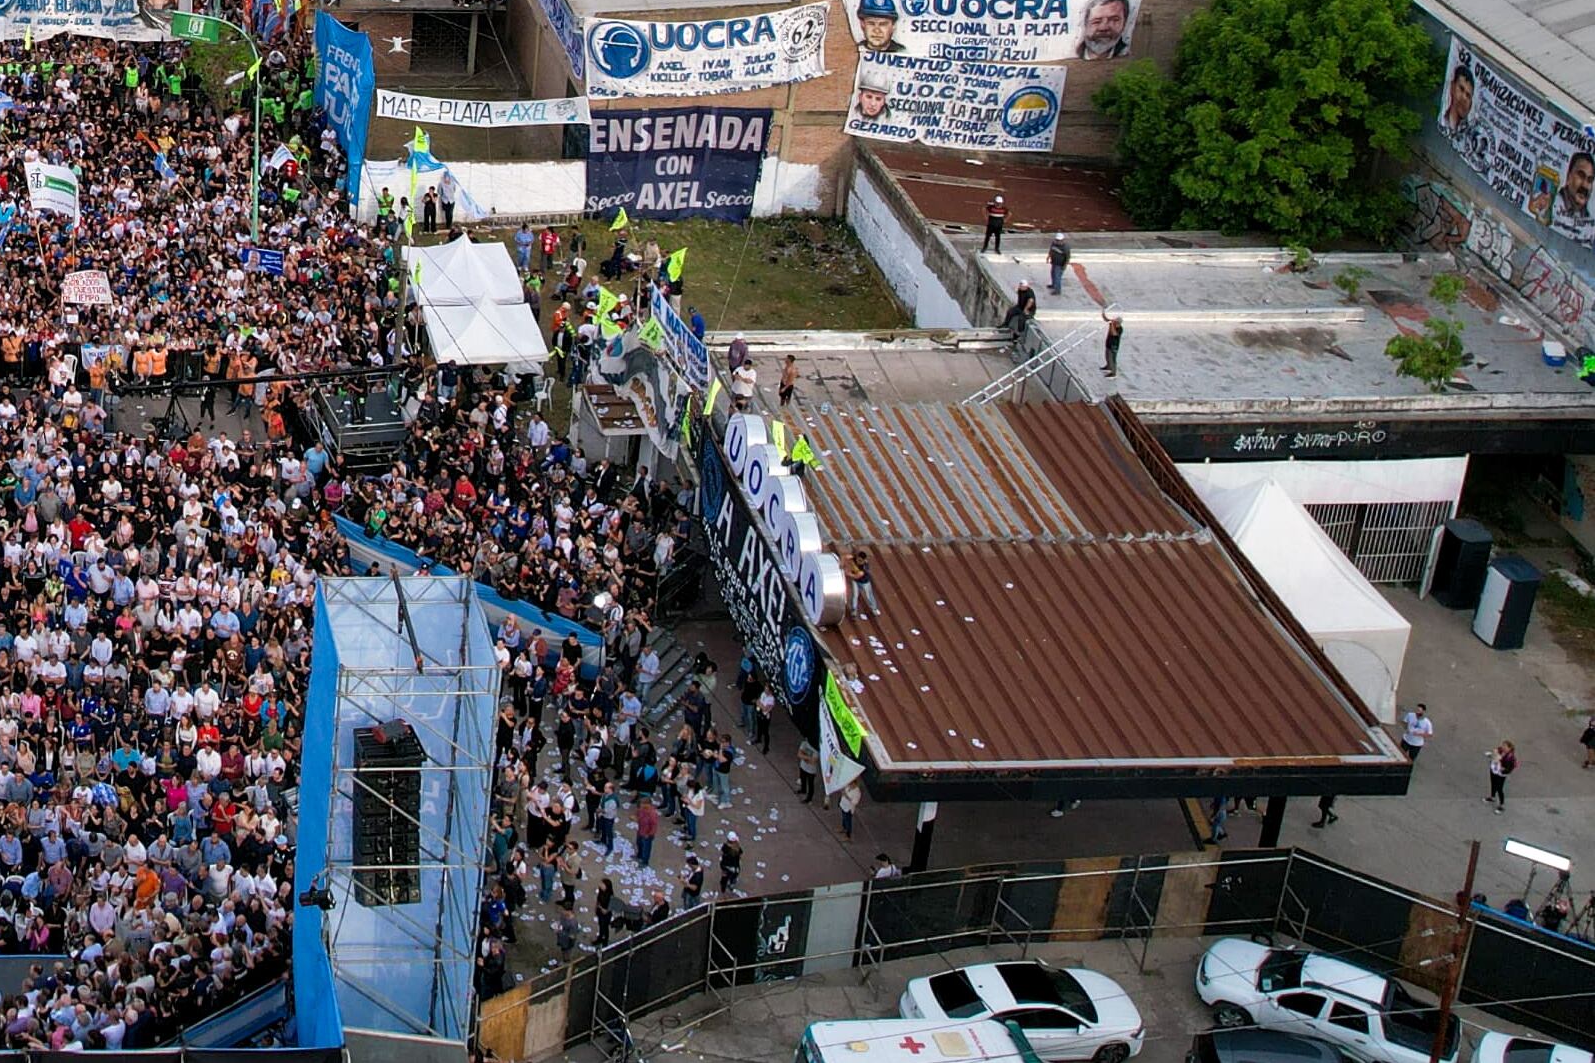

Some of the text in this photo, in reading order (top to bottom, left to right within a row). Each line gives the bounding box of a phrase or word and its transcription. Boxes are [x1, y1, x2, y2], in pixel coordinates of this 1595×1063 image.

[649, 15, 776, 51] UOCRA
[791, 20, 815, 45] 62
[911, 19, 1069, 37] SECCIONAL LA PLATA
[955, 37, 1018, 47] AGRUPACION
[1002, 46, 1037, 61] Azul
[657, 52, 776, 71] AXEL IVAN JULIO
[863, 51, 1041, 80] JUVENTUD SINDICAL
[1458, 46, 1472, 67] 62
[650, 64, 773, 83] KICILLOF TOBAR ALAK
[913, 72, 1001, 90] RODRIGO TOBAR
[381, 96, 423, 119] MAR
[438, 101, 493, 124] PLATA
[507, 102, 548, 122] AXEL
[889, 97, 1004, 123] SECCIONAL LA PLATA
[589, 114, 765, 153] ENSENADA
[848, 119, 997, 146] GERARDO MARTINEZ
[910, 115, 988, 133] IVAN TOBAR
[655, 155, 694, 176] CON
[587, 181, 753, 212] Secco AXEL Secco
[728, 422, 817, 614] UOCRA
